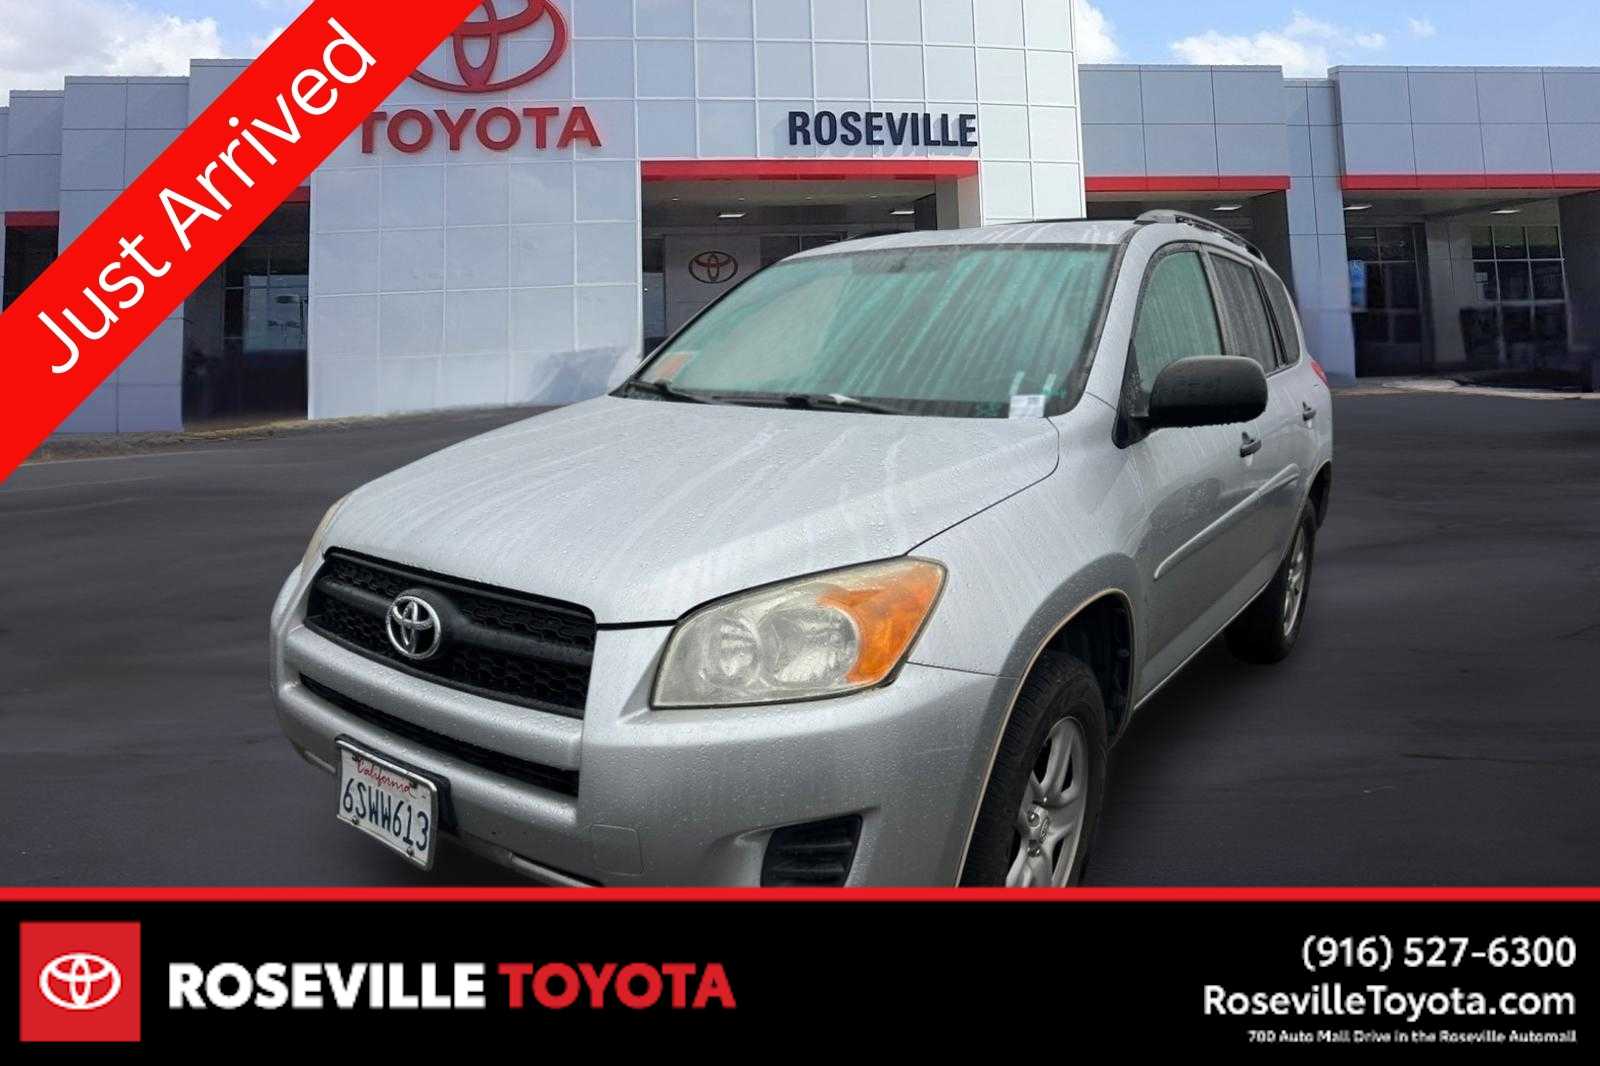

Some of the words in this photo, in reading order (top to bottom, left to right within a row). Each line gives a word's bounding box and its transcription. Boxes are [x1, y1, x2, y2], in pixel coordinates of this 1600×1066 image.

[361, 106, 602, 154] TOYOTA
[788, 110, 978, 148] ROSEVILLE
[354, 757, 415, 798] California
[343, 778, 429, 851] 6SWW613
